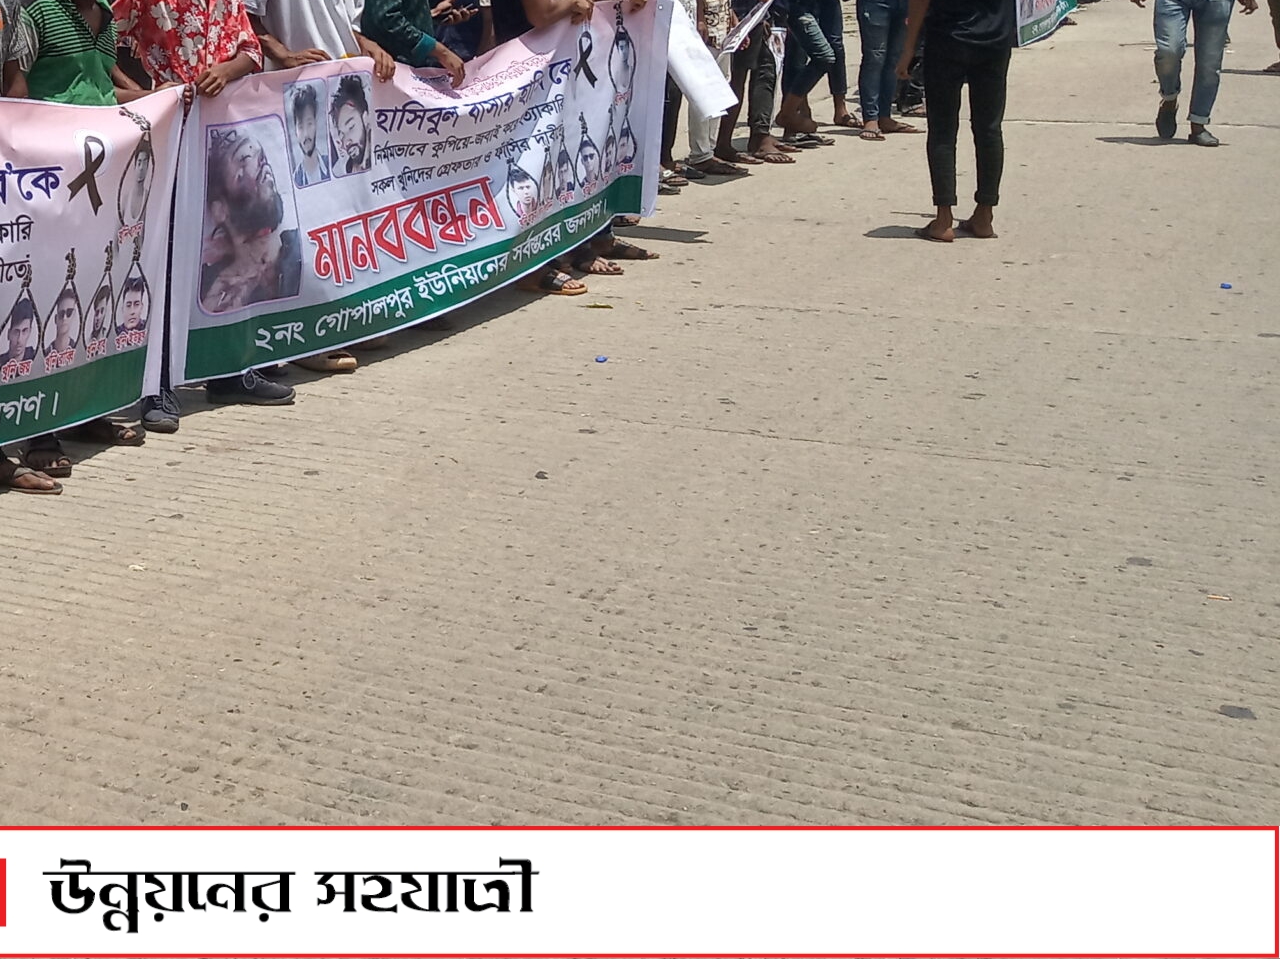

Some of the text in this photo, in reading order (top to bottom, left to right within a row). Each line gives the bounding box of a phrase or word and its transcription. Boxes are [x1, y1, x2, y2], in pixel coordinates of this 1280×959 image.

[375, 100, 460, 136] হাসিবুল
[371, 176, 396, 196] সকল
[307, 174, 506, 287] মানববন্ধন
[254, 321, 305, 352] ২নং
[315, 285, 414, 338] গোপালপুর
